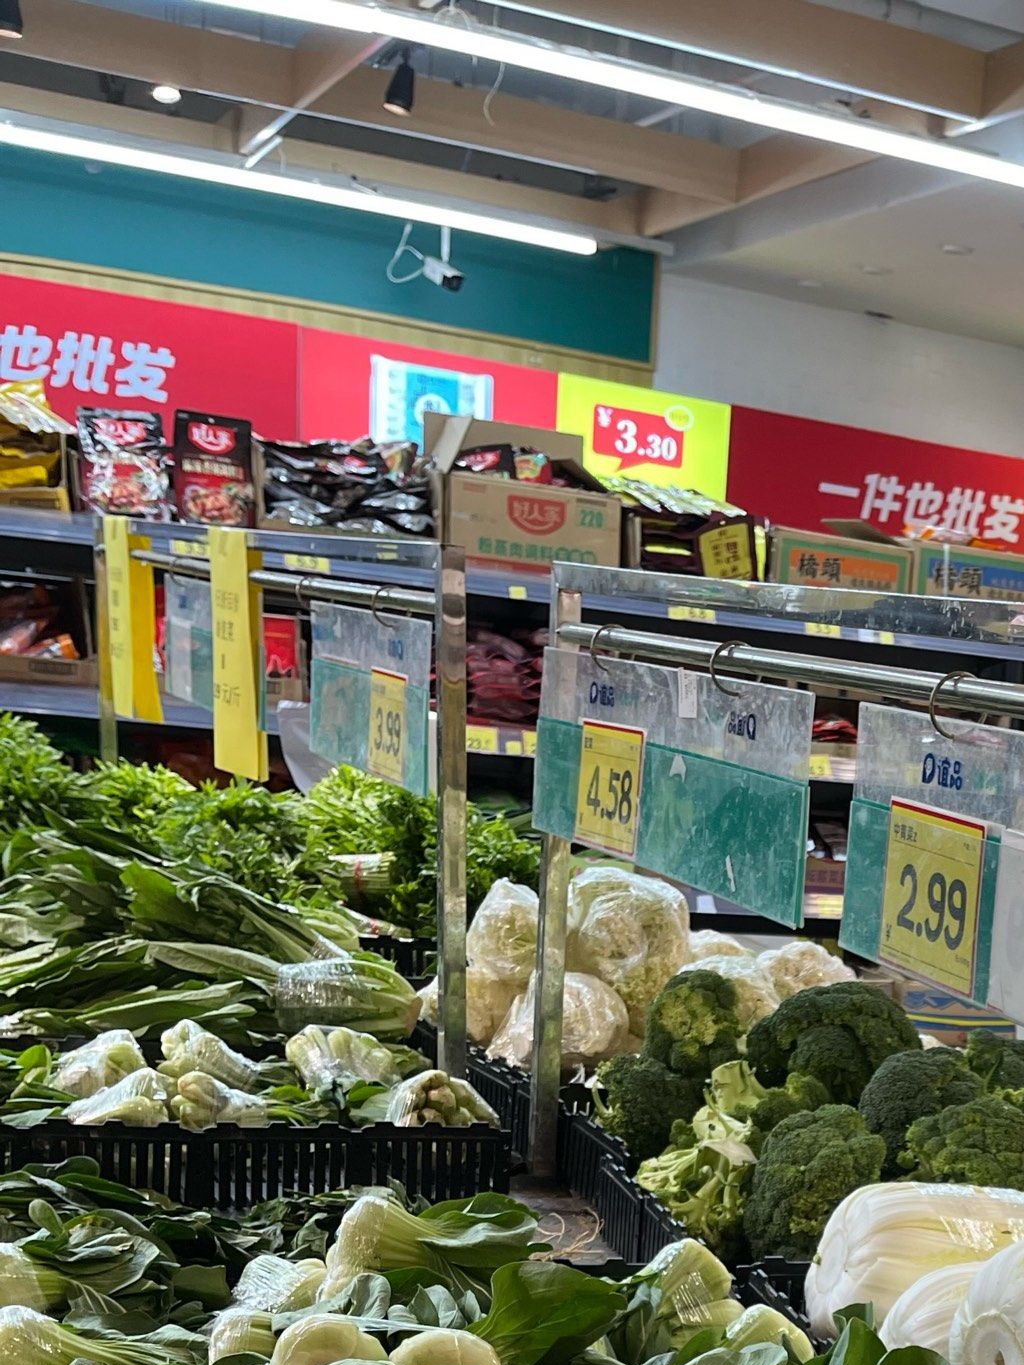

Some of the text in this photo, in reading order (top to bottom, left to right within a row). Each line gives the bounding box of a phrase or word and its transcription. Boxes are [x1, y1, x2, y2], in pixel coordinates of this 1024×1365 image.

[0, 325, 176, 403] 也批发
[374, 706, 402, 758] 3.99
[586, 765, 632, 826] 4.58
[937, 757, 963, 790] 谊品
[897, 863, 967, 950] 2.99
